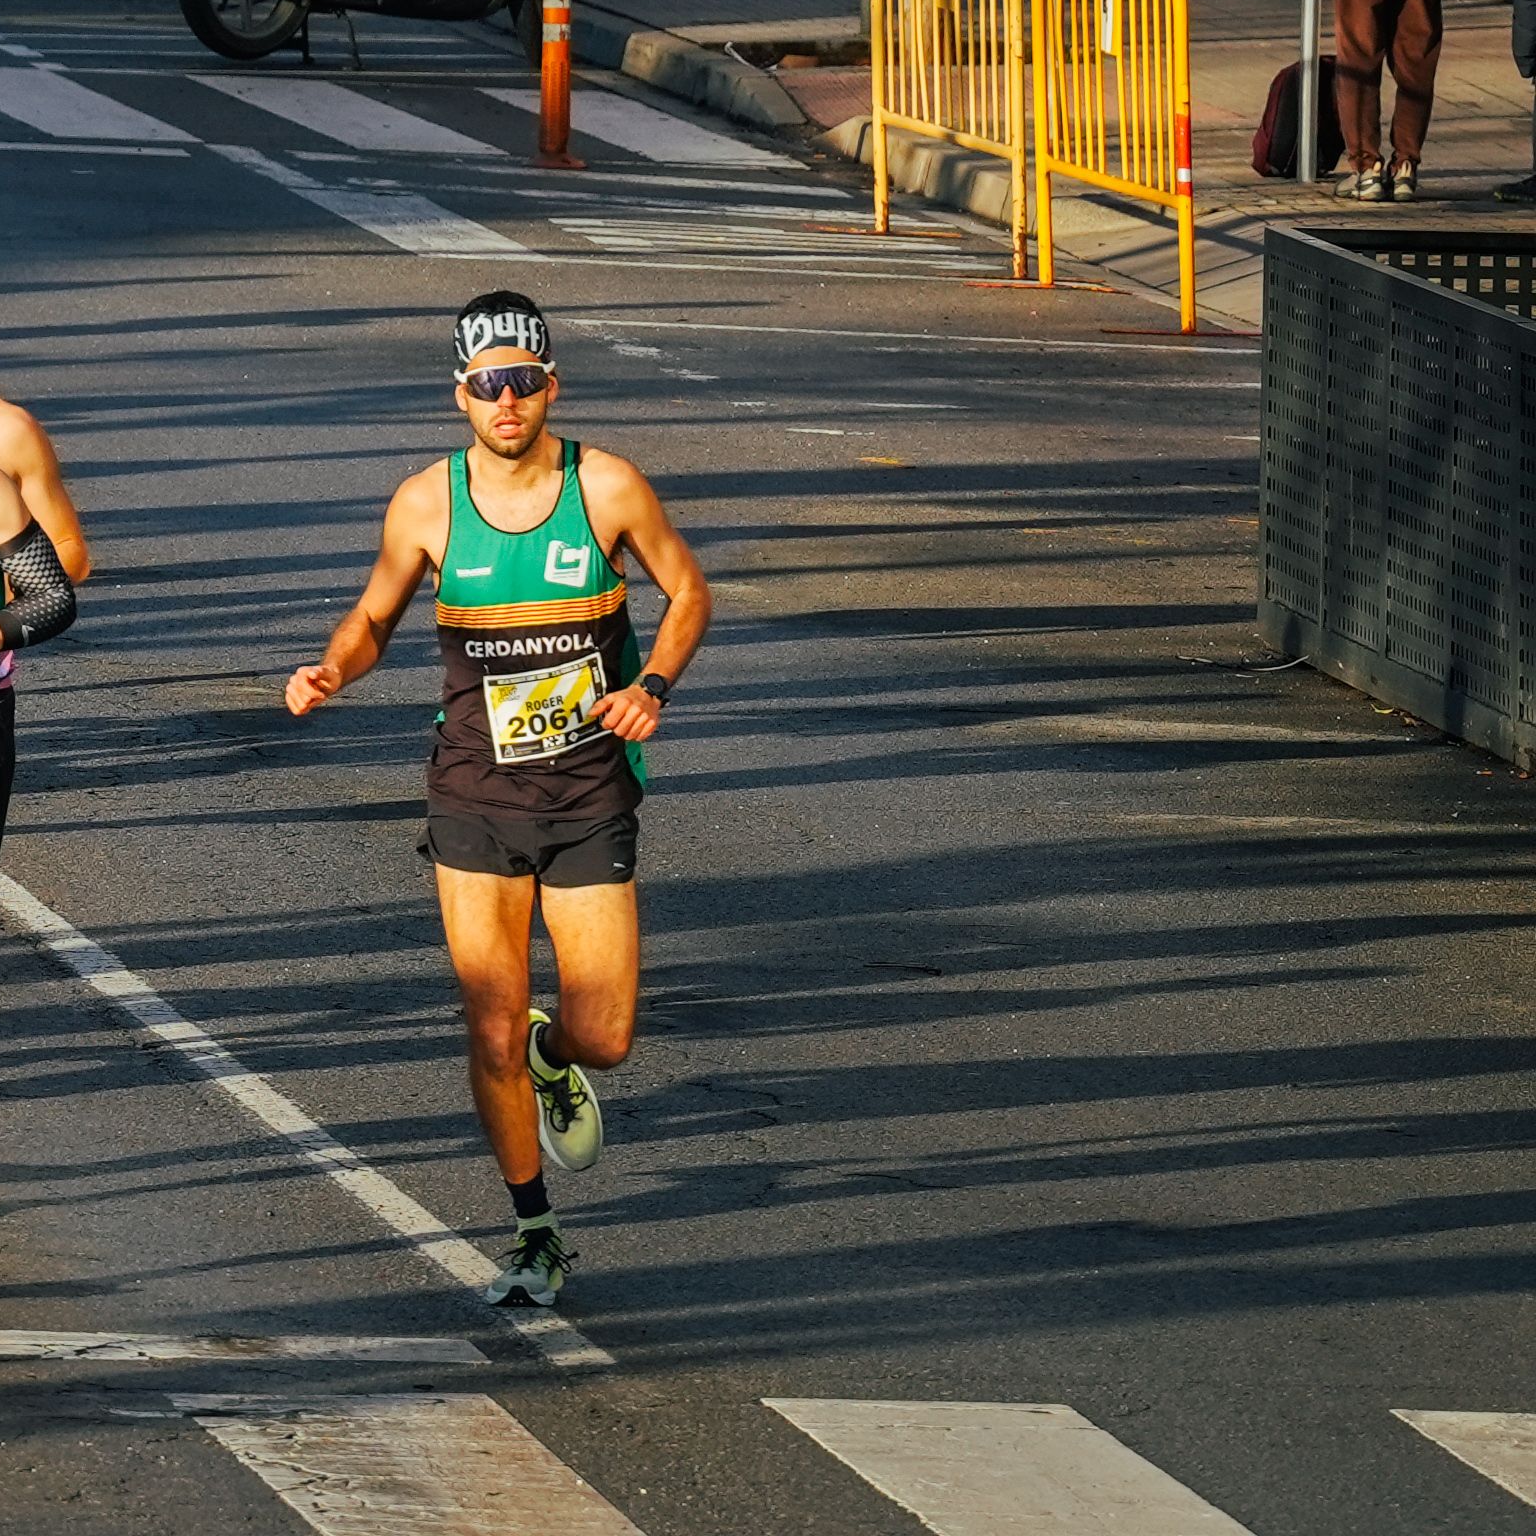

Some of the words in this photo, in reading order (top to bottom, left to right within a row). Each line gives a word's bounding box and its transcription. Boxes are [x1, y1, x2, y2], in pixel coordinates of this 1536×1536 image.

[464, 632, 595, 659] CERDANYOLA
[525, 695, 564, 713] ROGER
[508, 701, 584, 739] 2061
